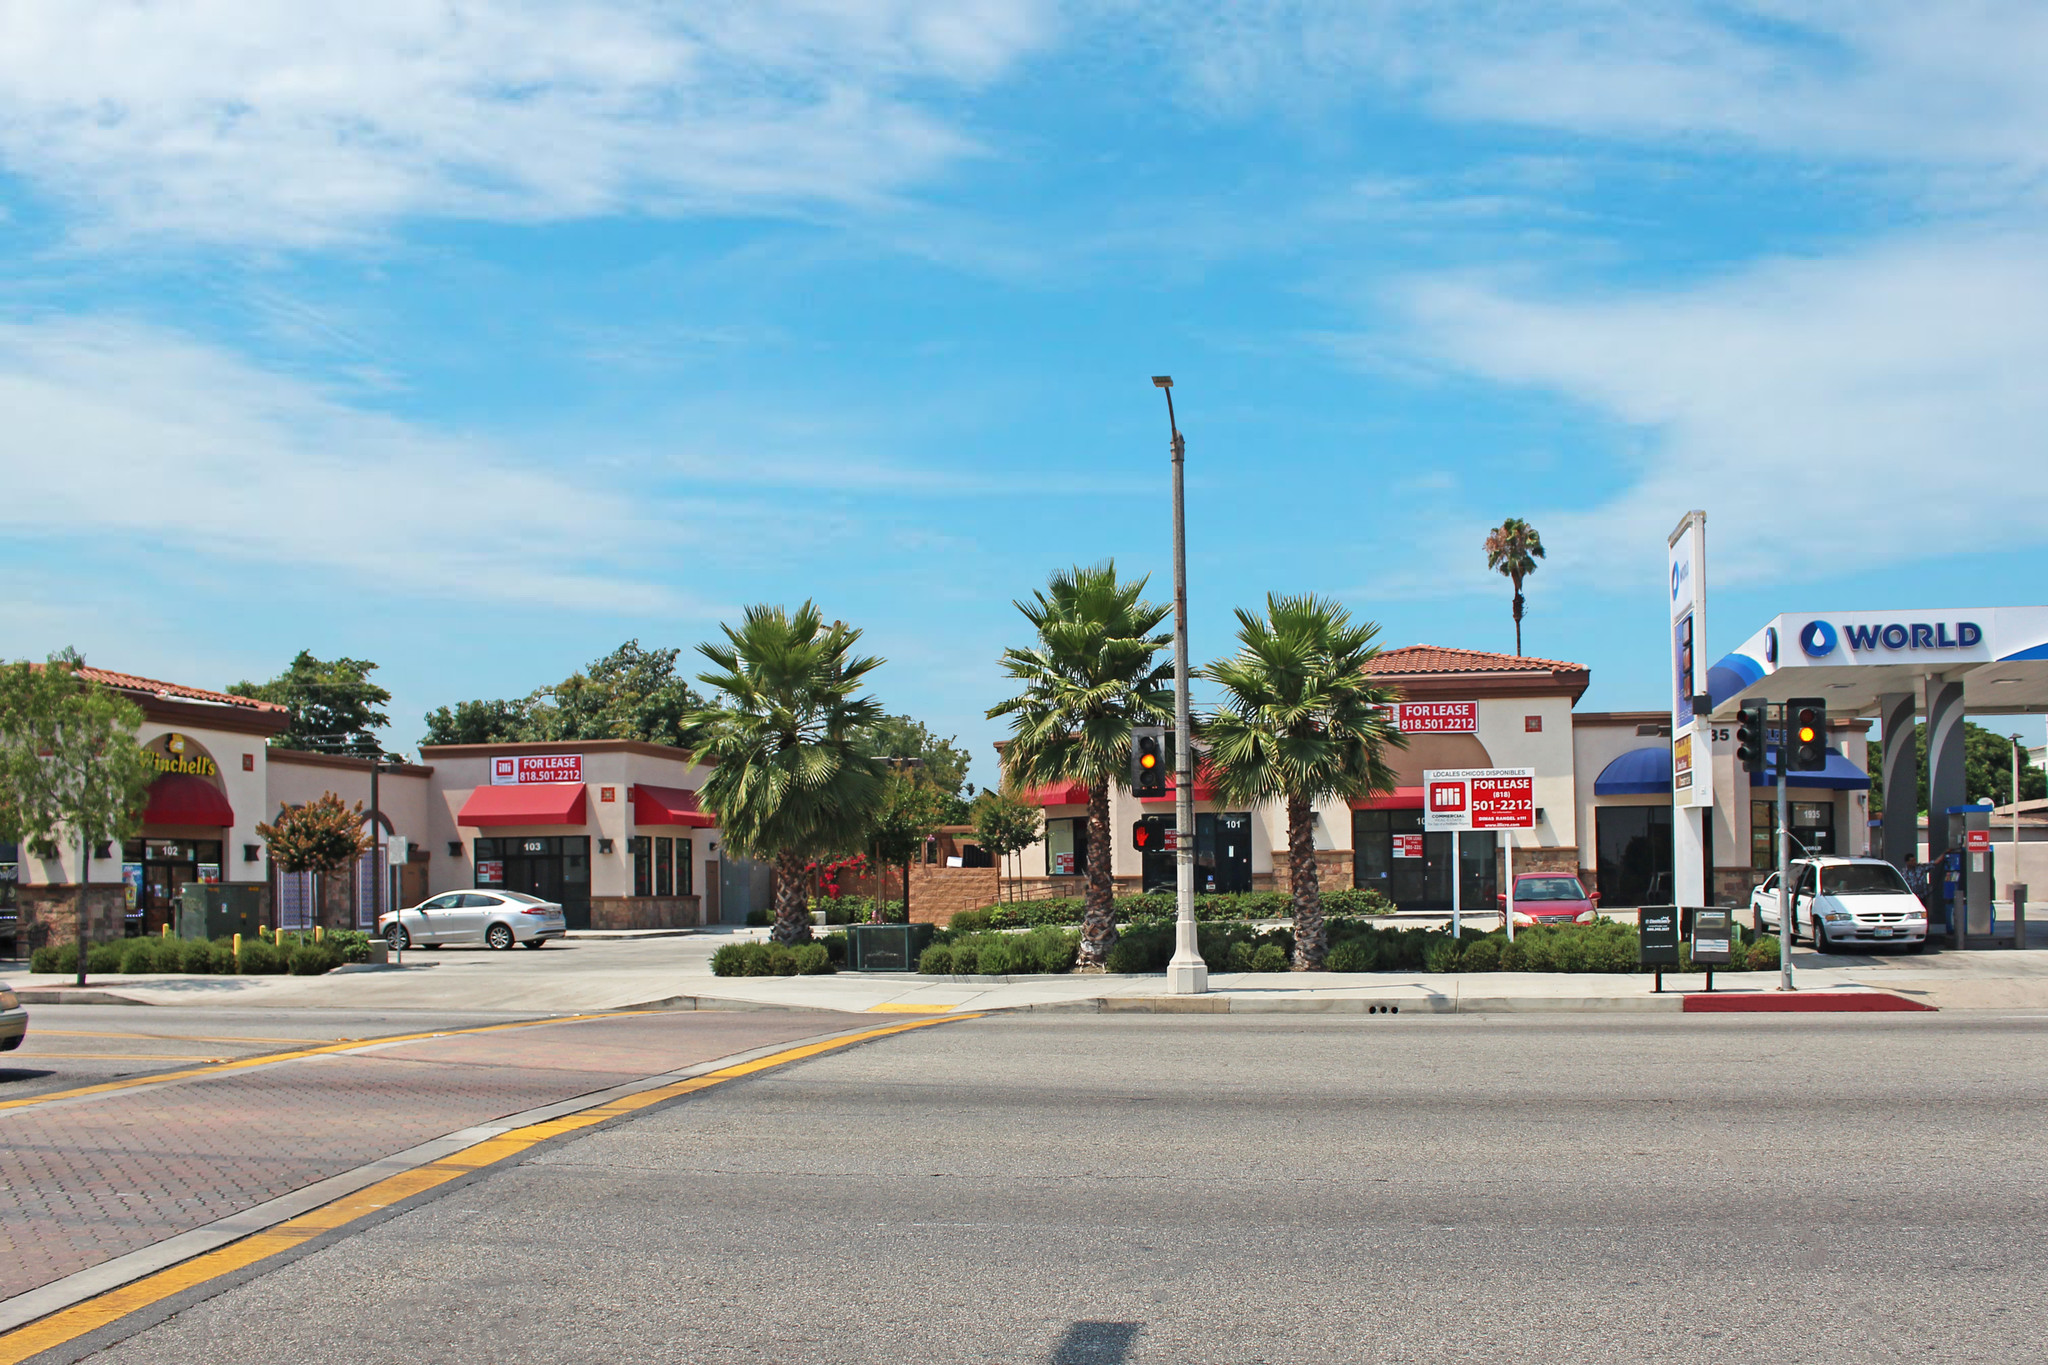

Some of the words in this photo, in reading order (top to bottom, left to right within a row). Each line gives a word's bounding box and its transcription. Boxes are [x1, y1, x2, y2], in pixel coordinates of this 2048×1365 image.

[1843, 622, 1983, 650] WORLD
[1406, 705, 1430, 716] FOR
[1432, 705, 1469, 716] LEASE
[1401, 718, 1475, 730] 818.501.2212
[140, 751, 216, 776] Winchell's
[524, 759, 543, 769] FOR
[545, 758, 576, 768] LEASE
[519, 770, 580, 781] 818.501.2212
[1473, 780, 1496, 790] FOR
[1497, 779, 1530, 789] LEASE
[1435, 788, 1460, 806] illi
[1472, 799, 1532, 811] 501-2212
[1804, 810, 1821, 819] 1935
[1226, 820, 1241, 829] 101
[1416, 817, 1425, 825] 10
[163, 846, 178, 856] 102
[524, 842, 541, 851] 103
